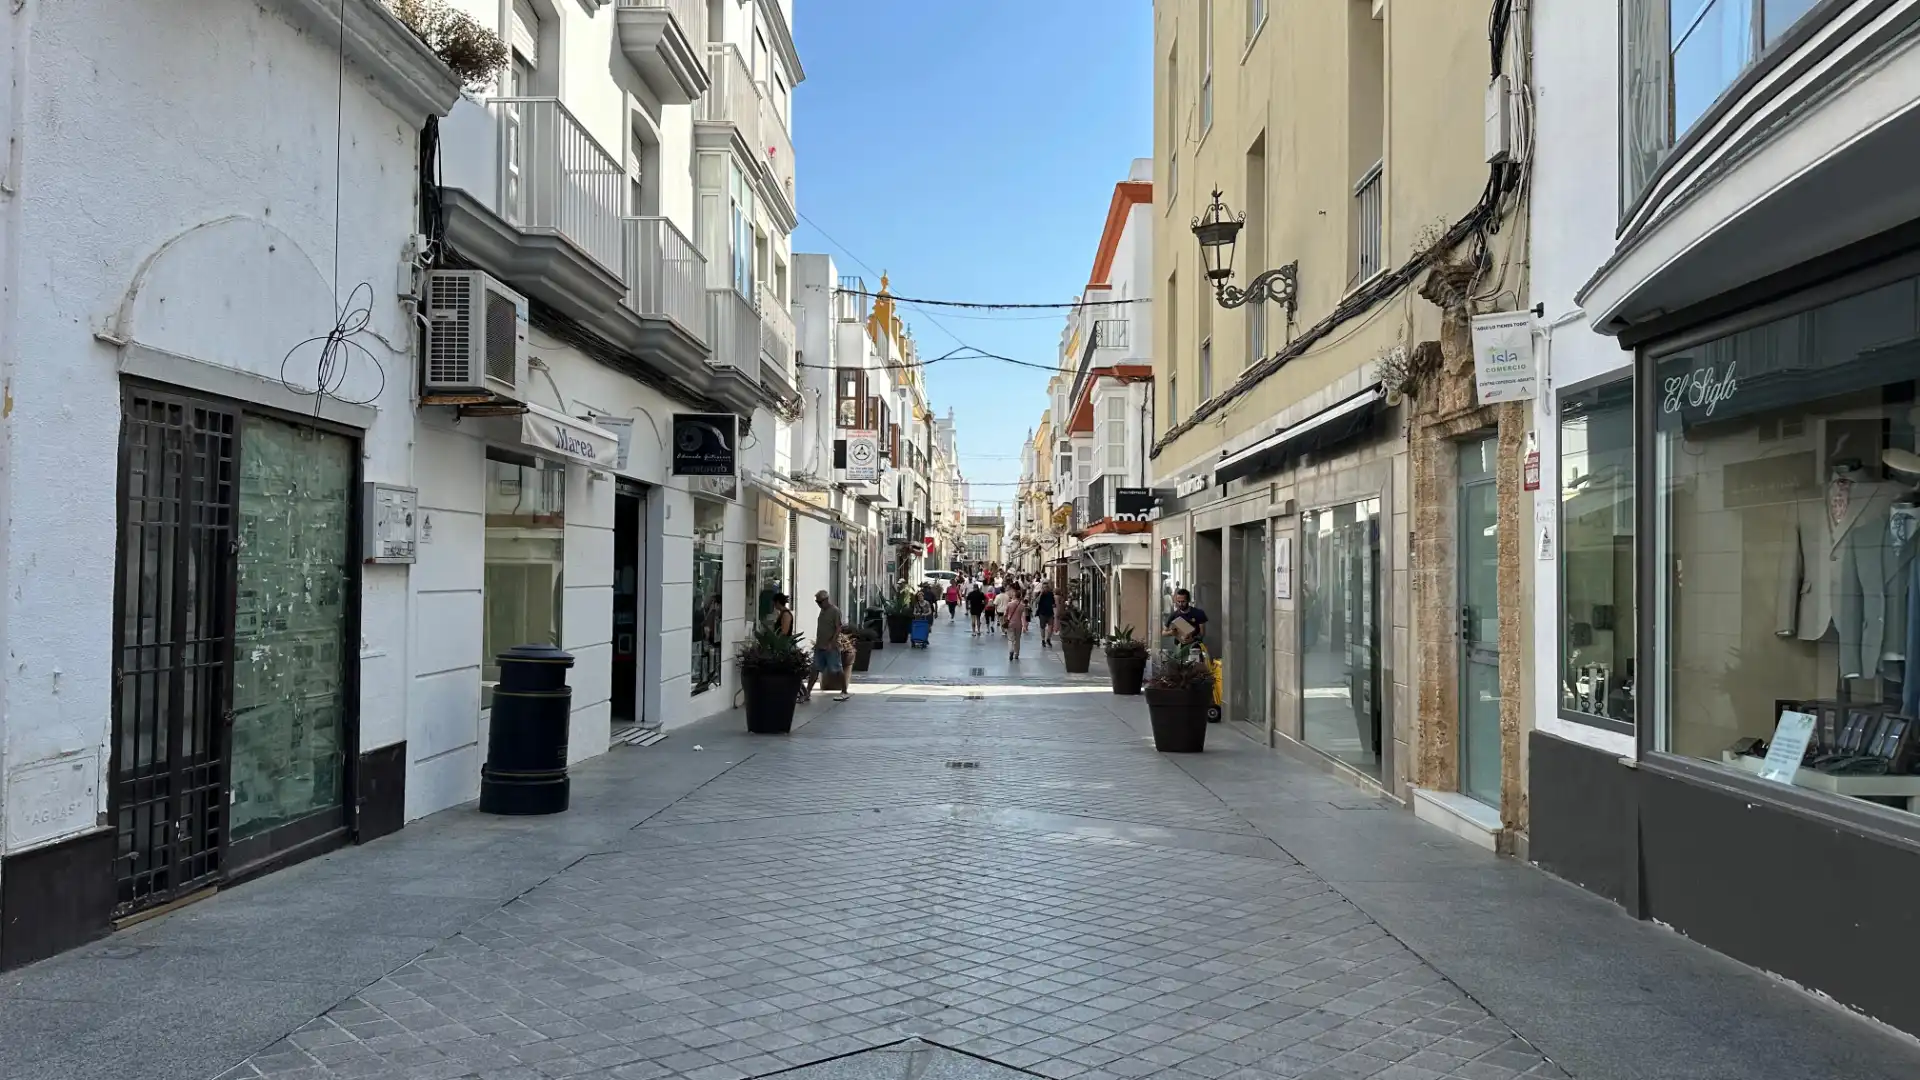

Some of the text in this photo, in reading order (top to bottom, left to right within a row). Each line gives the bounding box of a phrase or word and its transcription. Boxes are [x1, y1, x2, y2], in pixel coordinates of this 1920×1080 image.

[1491, 346, 1518, 363] isla
[1485, 363, 1526, 373] COMERCIO
[1664, 361, 1738, 416] El Siglo
[554, 425, 596, 459] Marea.
